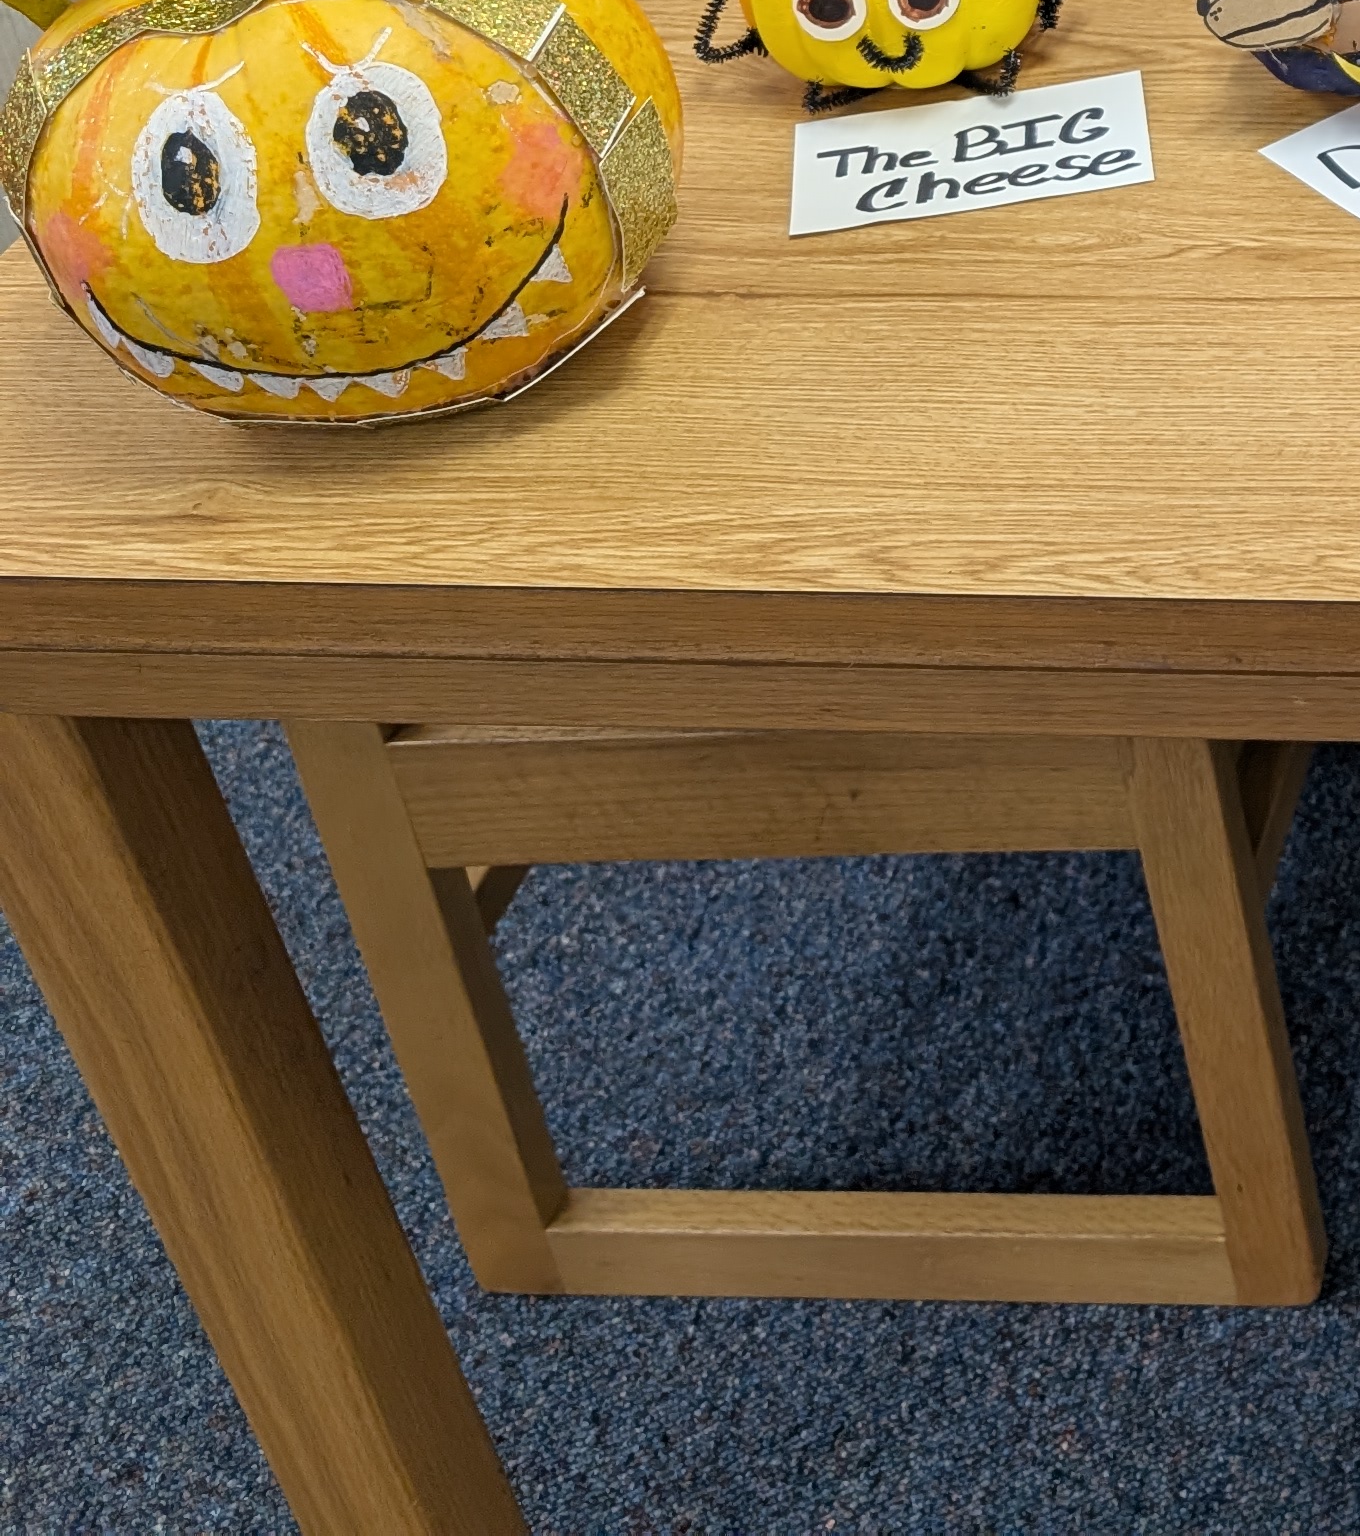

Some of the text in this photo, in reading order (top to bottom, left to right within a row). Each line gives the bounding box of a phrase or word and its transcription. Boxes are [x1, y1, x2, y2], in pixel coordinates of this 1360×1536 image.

[816, 107, 1110, 178] The BIG
[855, 148, 1142, 213] Cheese
